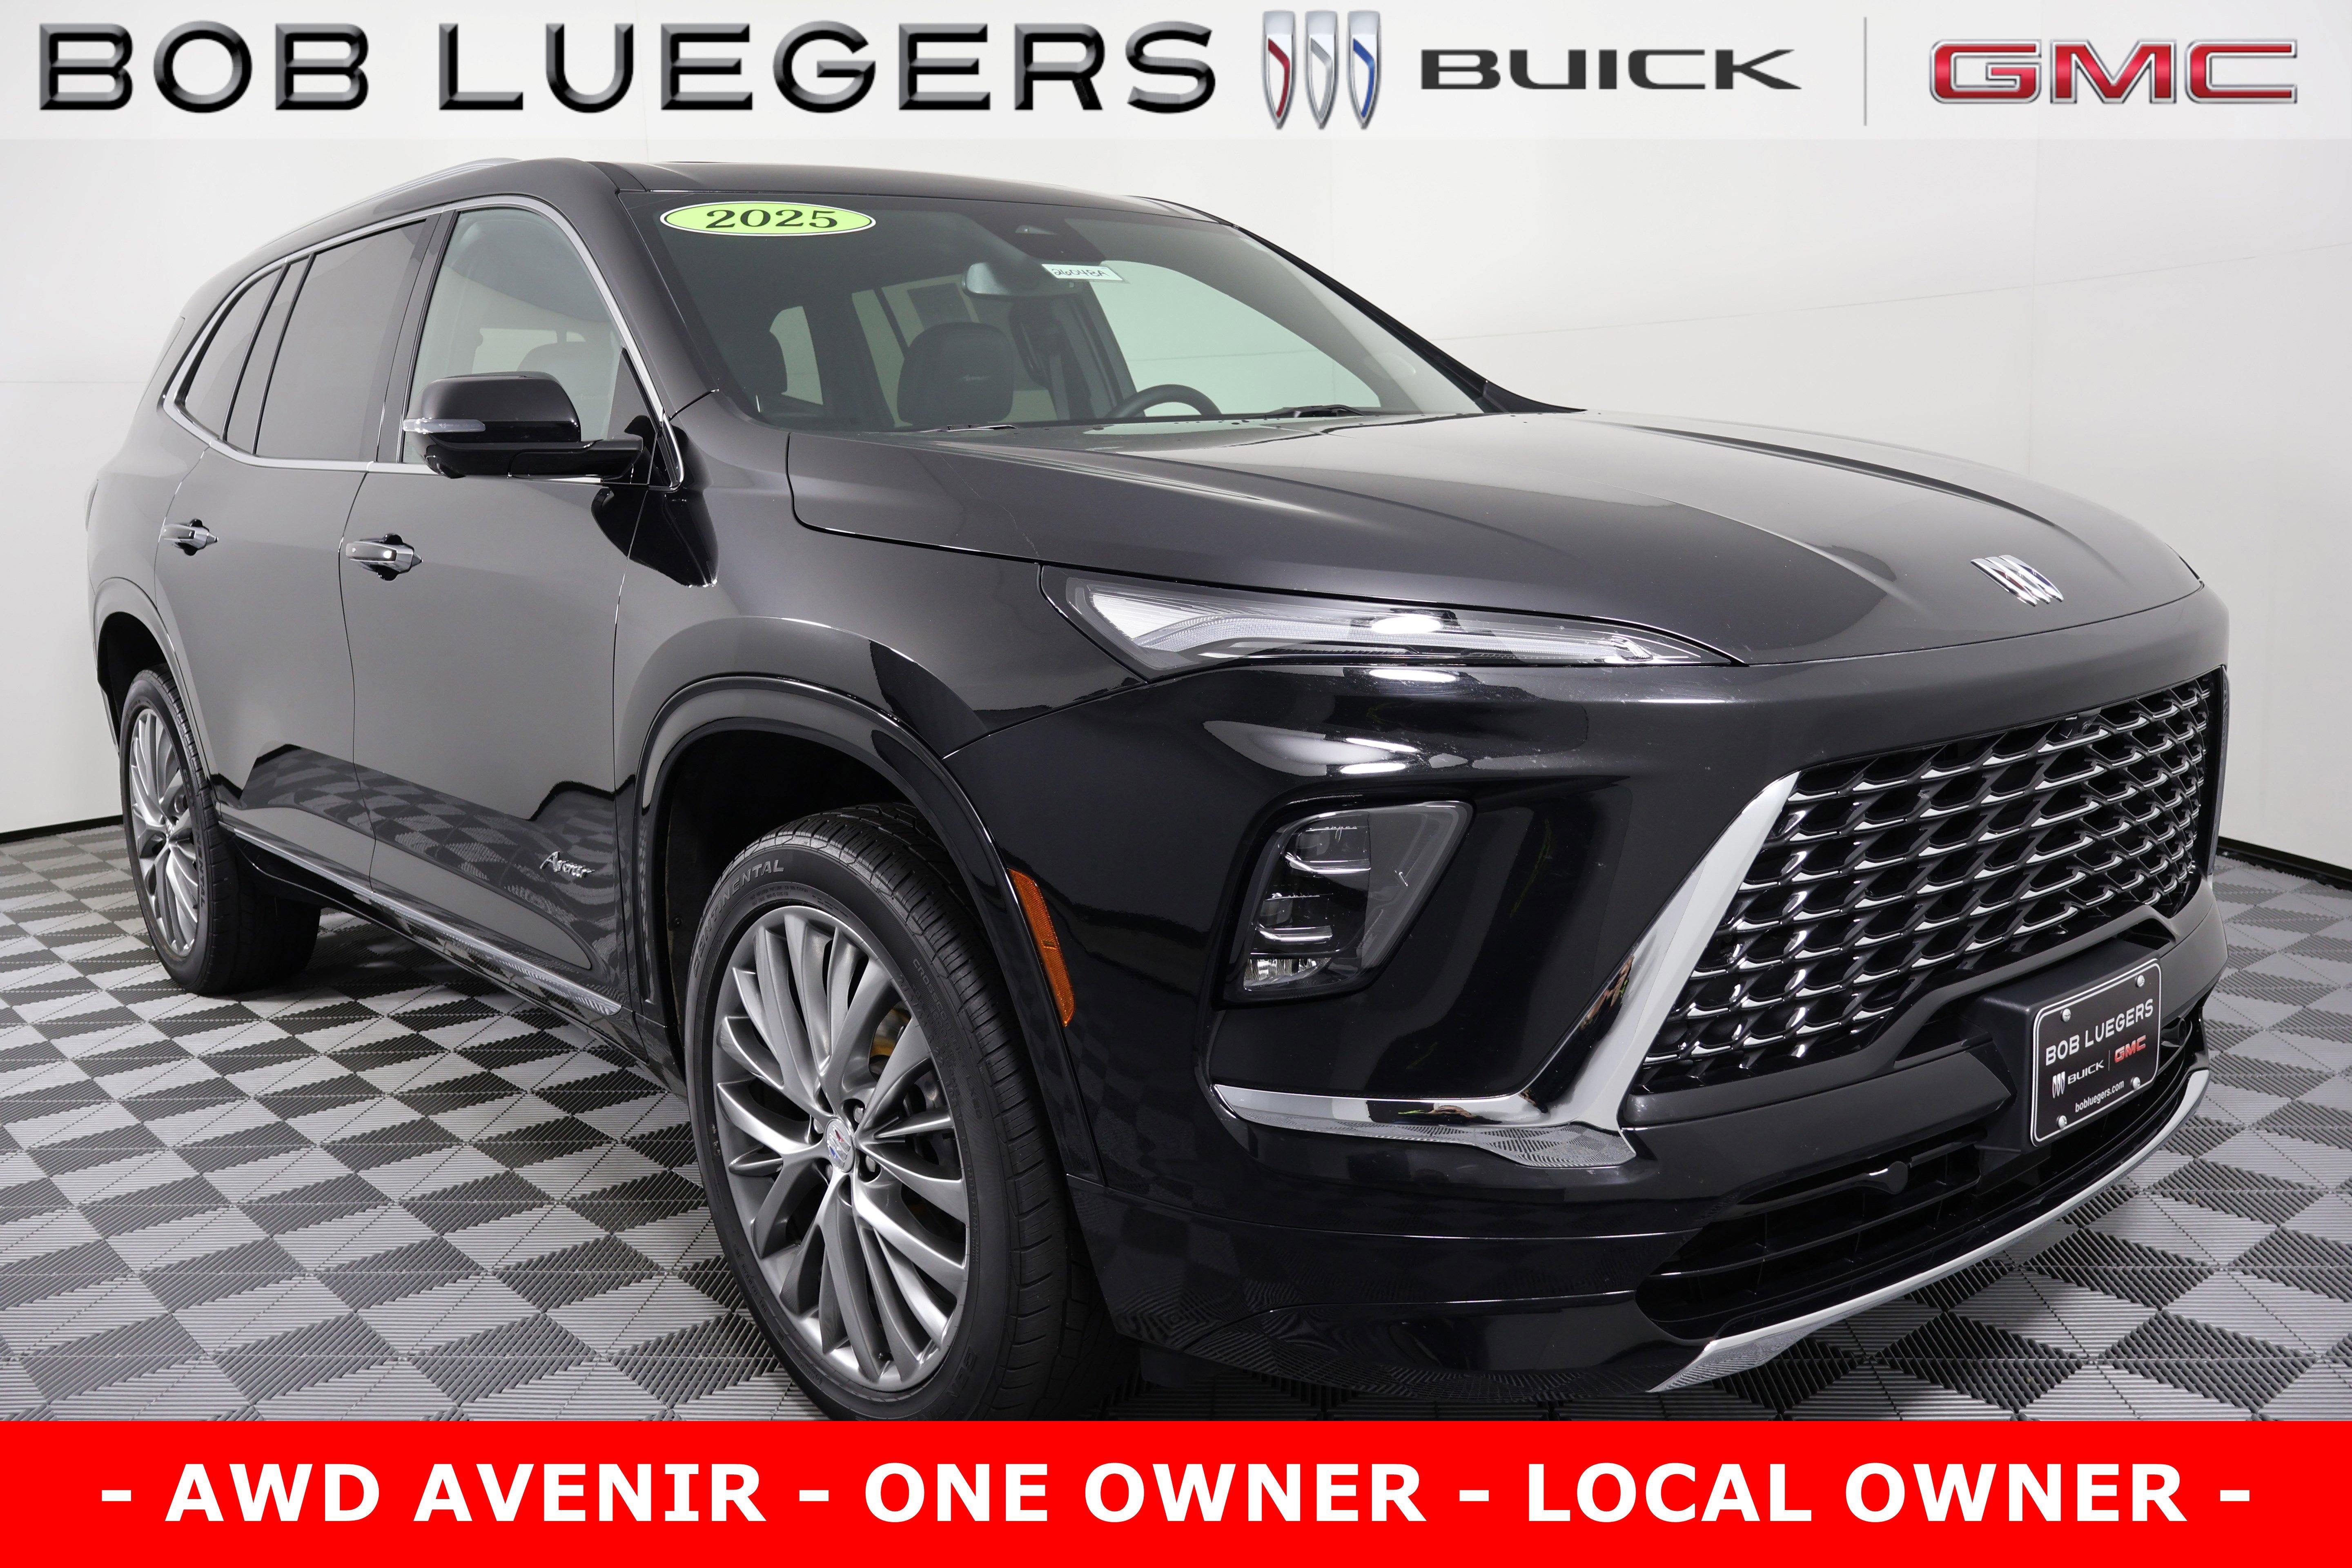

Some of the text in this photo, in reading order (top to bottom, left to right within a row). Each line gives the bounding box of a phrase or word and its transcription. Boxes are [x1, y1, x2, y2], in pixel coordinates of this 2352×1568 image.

[705, 209, 839, 229] 2025
[1051, 268, 1110, 277] 26048A
[2045, 998, 2154, 1066] BOB LUEGERS
[2114, 1034, 2147, 1063] GMC
[2067, 1059, 2105, 1085] BUICK
[2075, 1080, 2125, 1113] bobluegers.com
